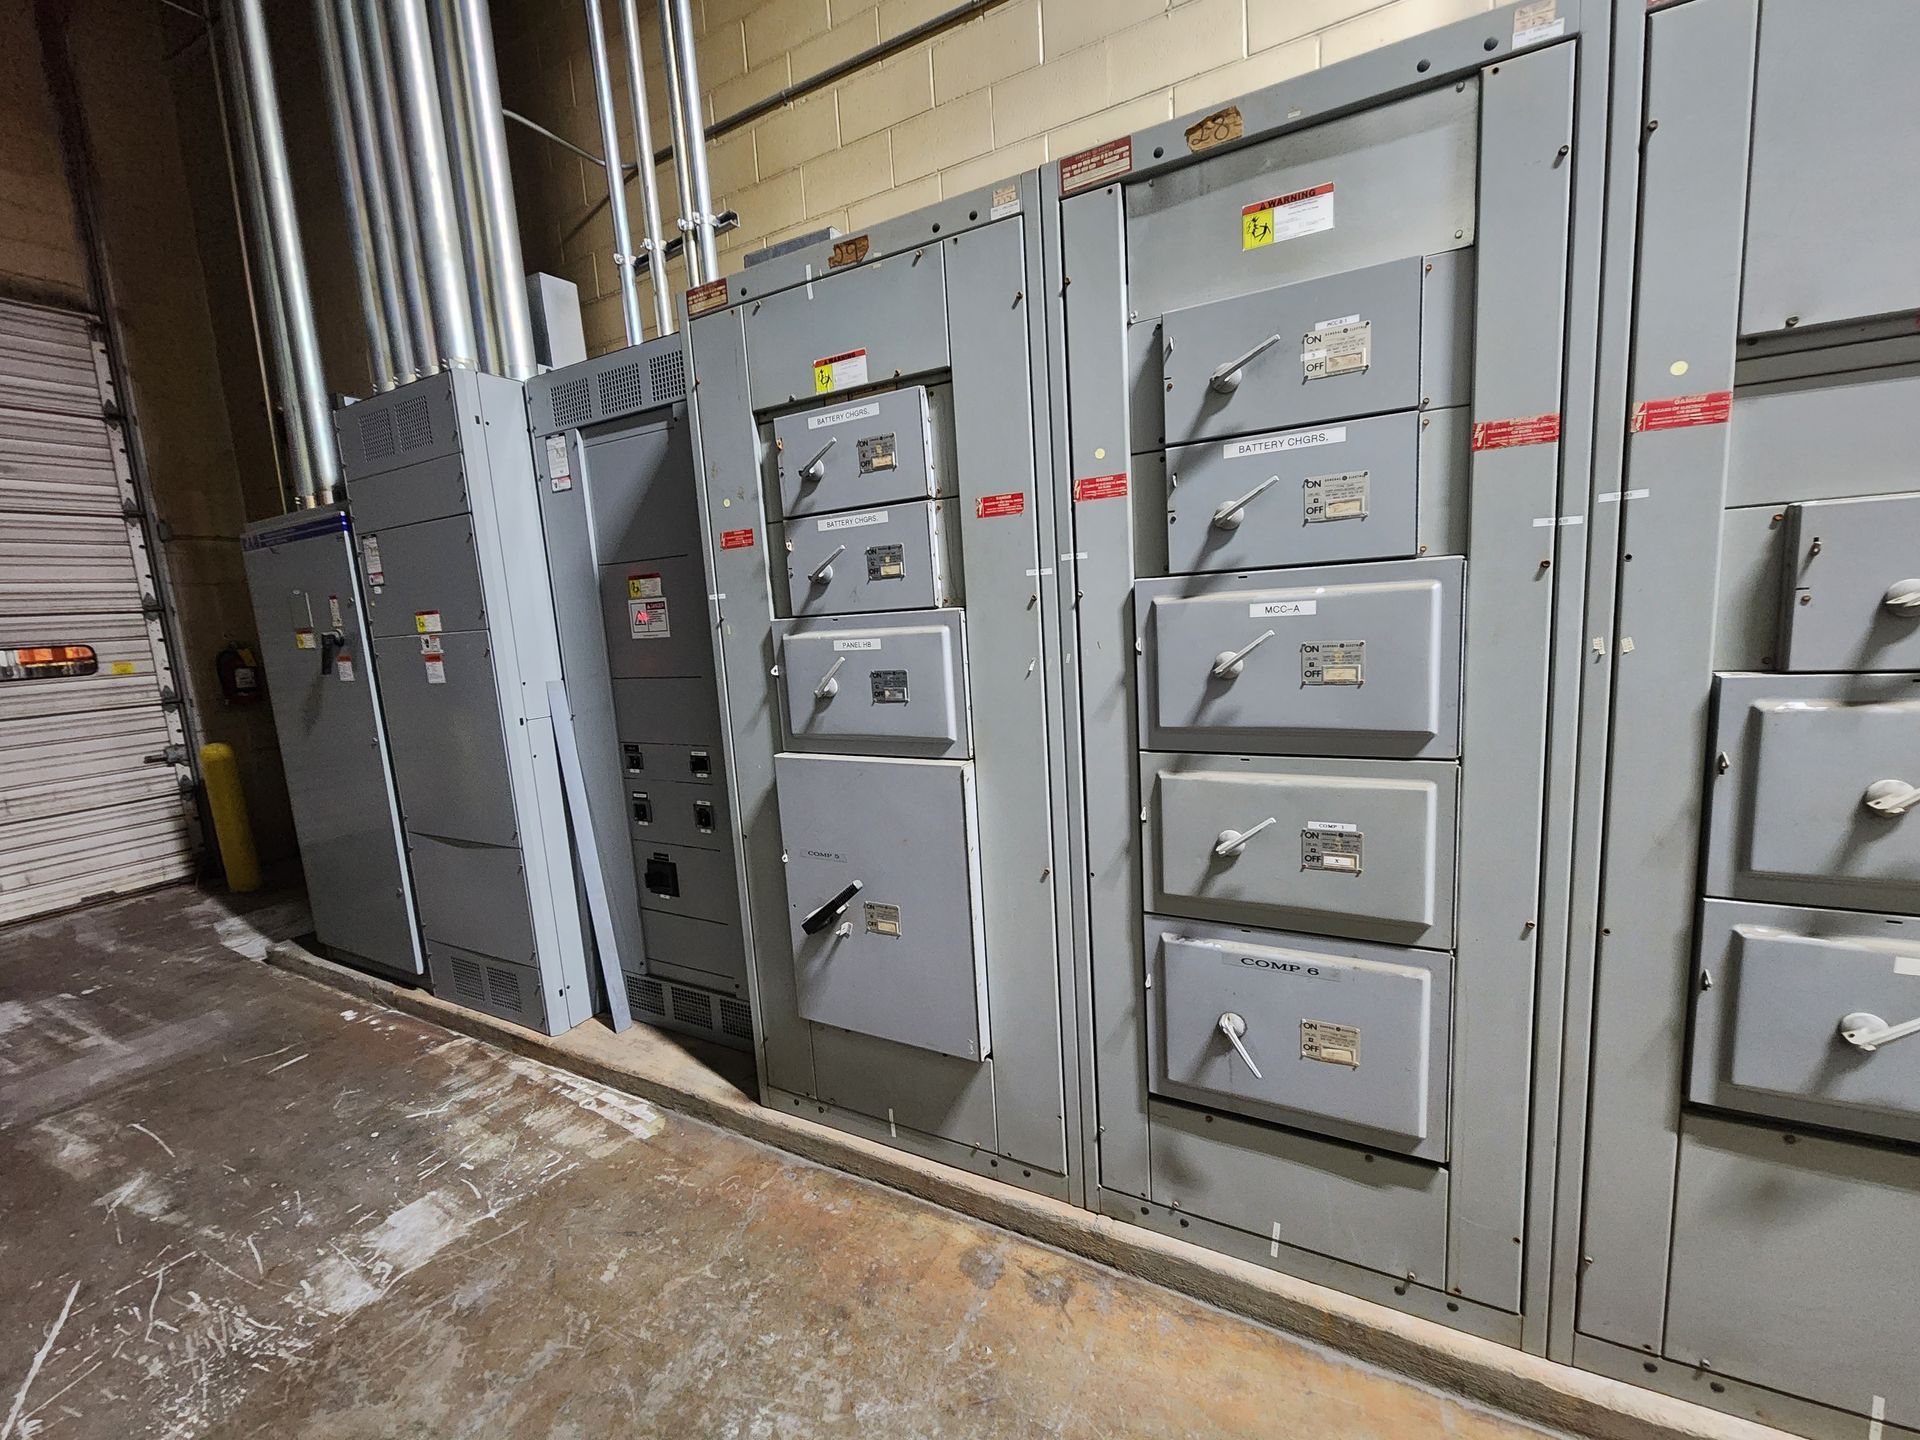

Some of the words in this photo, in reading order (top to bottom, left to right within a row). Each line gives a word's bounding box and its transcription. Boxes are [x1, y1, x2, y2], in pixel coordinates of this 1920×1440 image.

[1268, 188, 1316, 208] WARNING
[1306, 334, 1322, 345] ON
[1306, 361, 1325, 373] OFF
[817, 413, 844, 425] BATTERY
[1238, 439, 1285, 454] BATTERY
[1287, 433, 1329, 447] CHGRS.
[1306, 480, 1322, 489] ON
[1306, 506, 1324, 515] OFF
[826, 518, 853, 529] BATTERY
[1265, 604, 1300, 614] MCC-A
[1304, 645, 1320, 653] ON
[1304, 670, 1322, 678] OFF
[1304, 831, 1320, 840] ON
[807, 850, 832, 859] COMP
[1304, 854, 1322, 863] OFF
[1240, 957, 1301, 973] COMP
[1307, 967, 1320, 976] 6
[1303, 1022, 1318, 1031] ON
[1303, 1043, 1320, 1053] OFF
